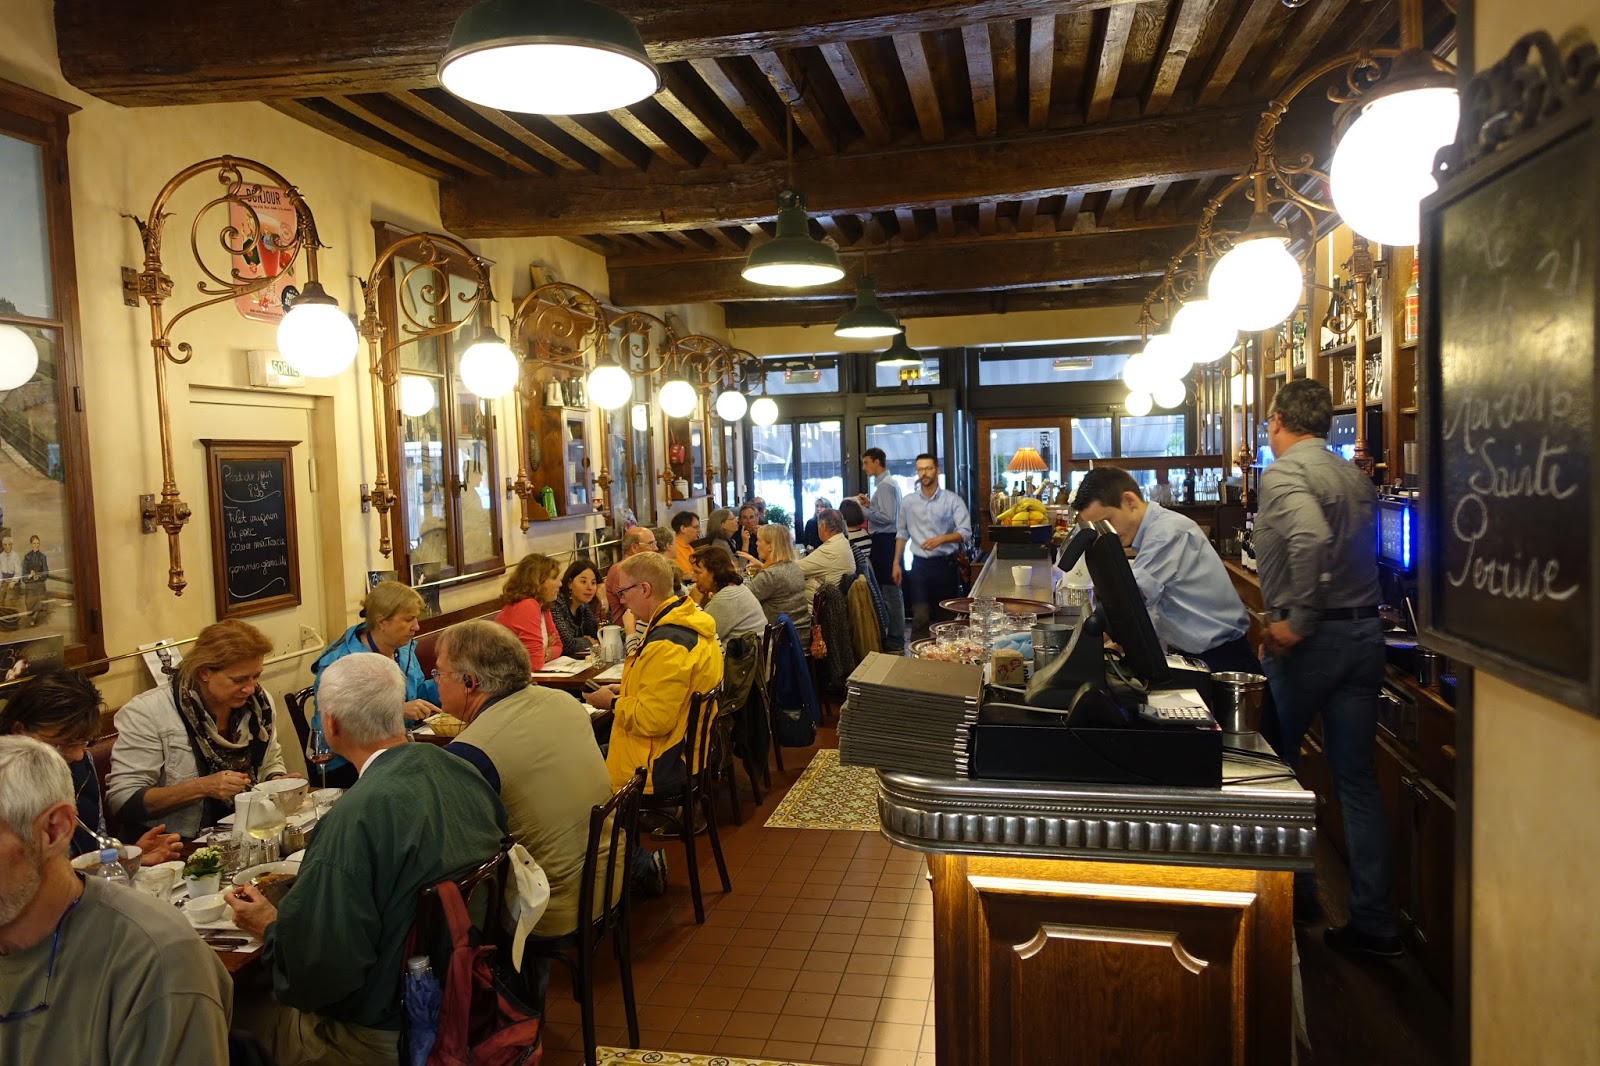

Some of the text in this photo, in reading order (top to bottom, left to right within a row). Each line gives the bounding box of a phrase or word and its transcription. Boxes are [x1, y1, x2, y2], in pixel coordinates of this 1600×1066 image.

[1468, 436, 1579, 499] Sainte
[223, 506, 279, 527] Filet mignon
[239, 527, 257, 541] porc
[1447, 493, 1580, 601] Perrine
